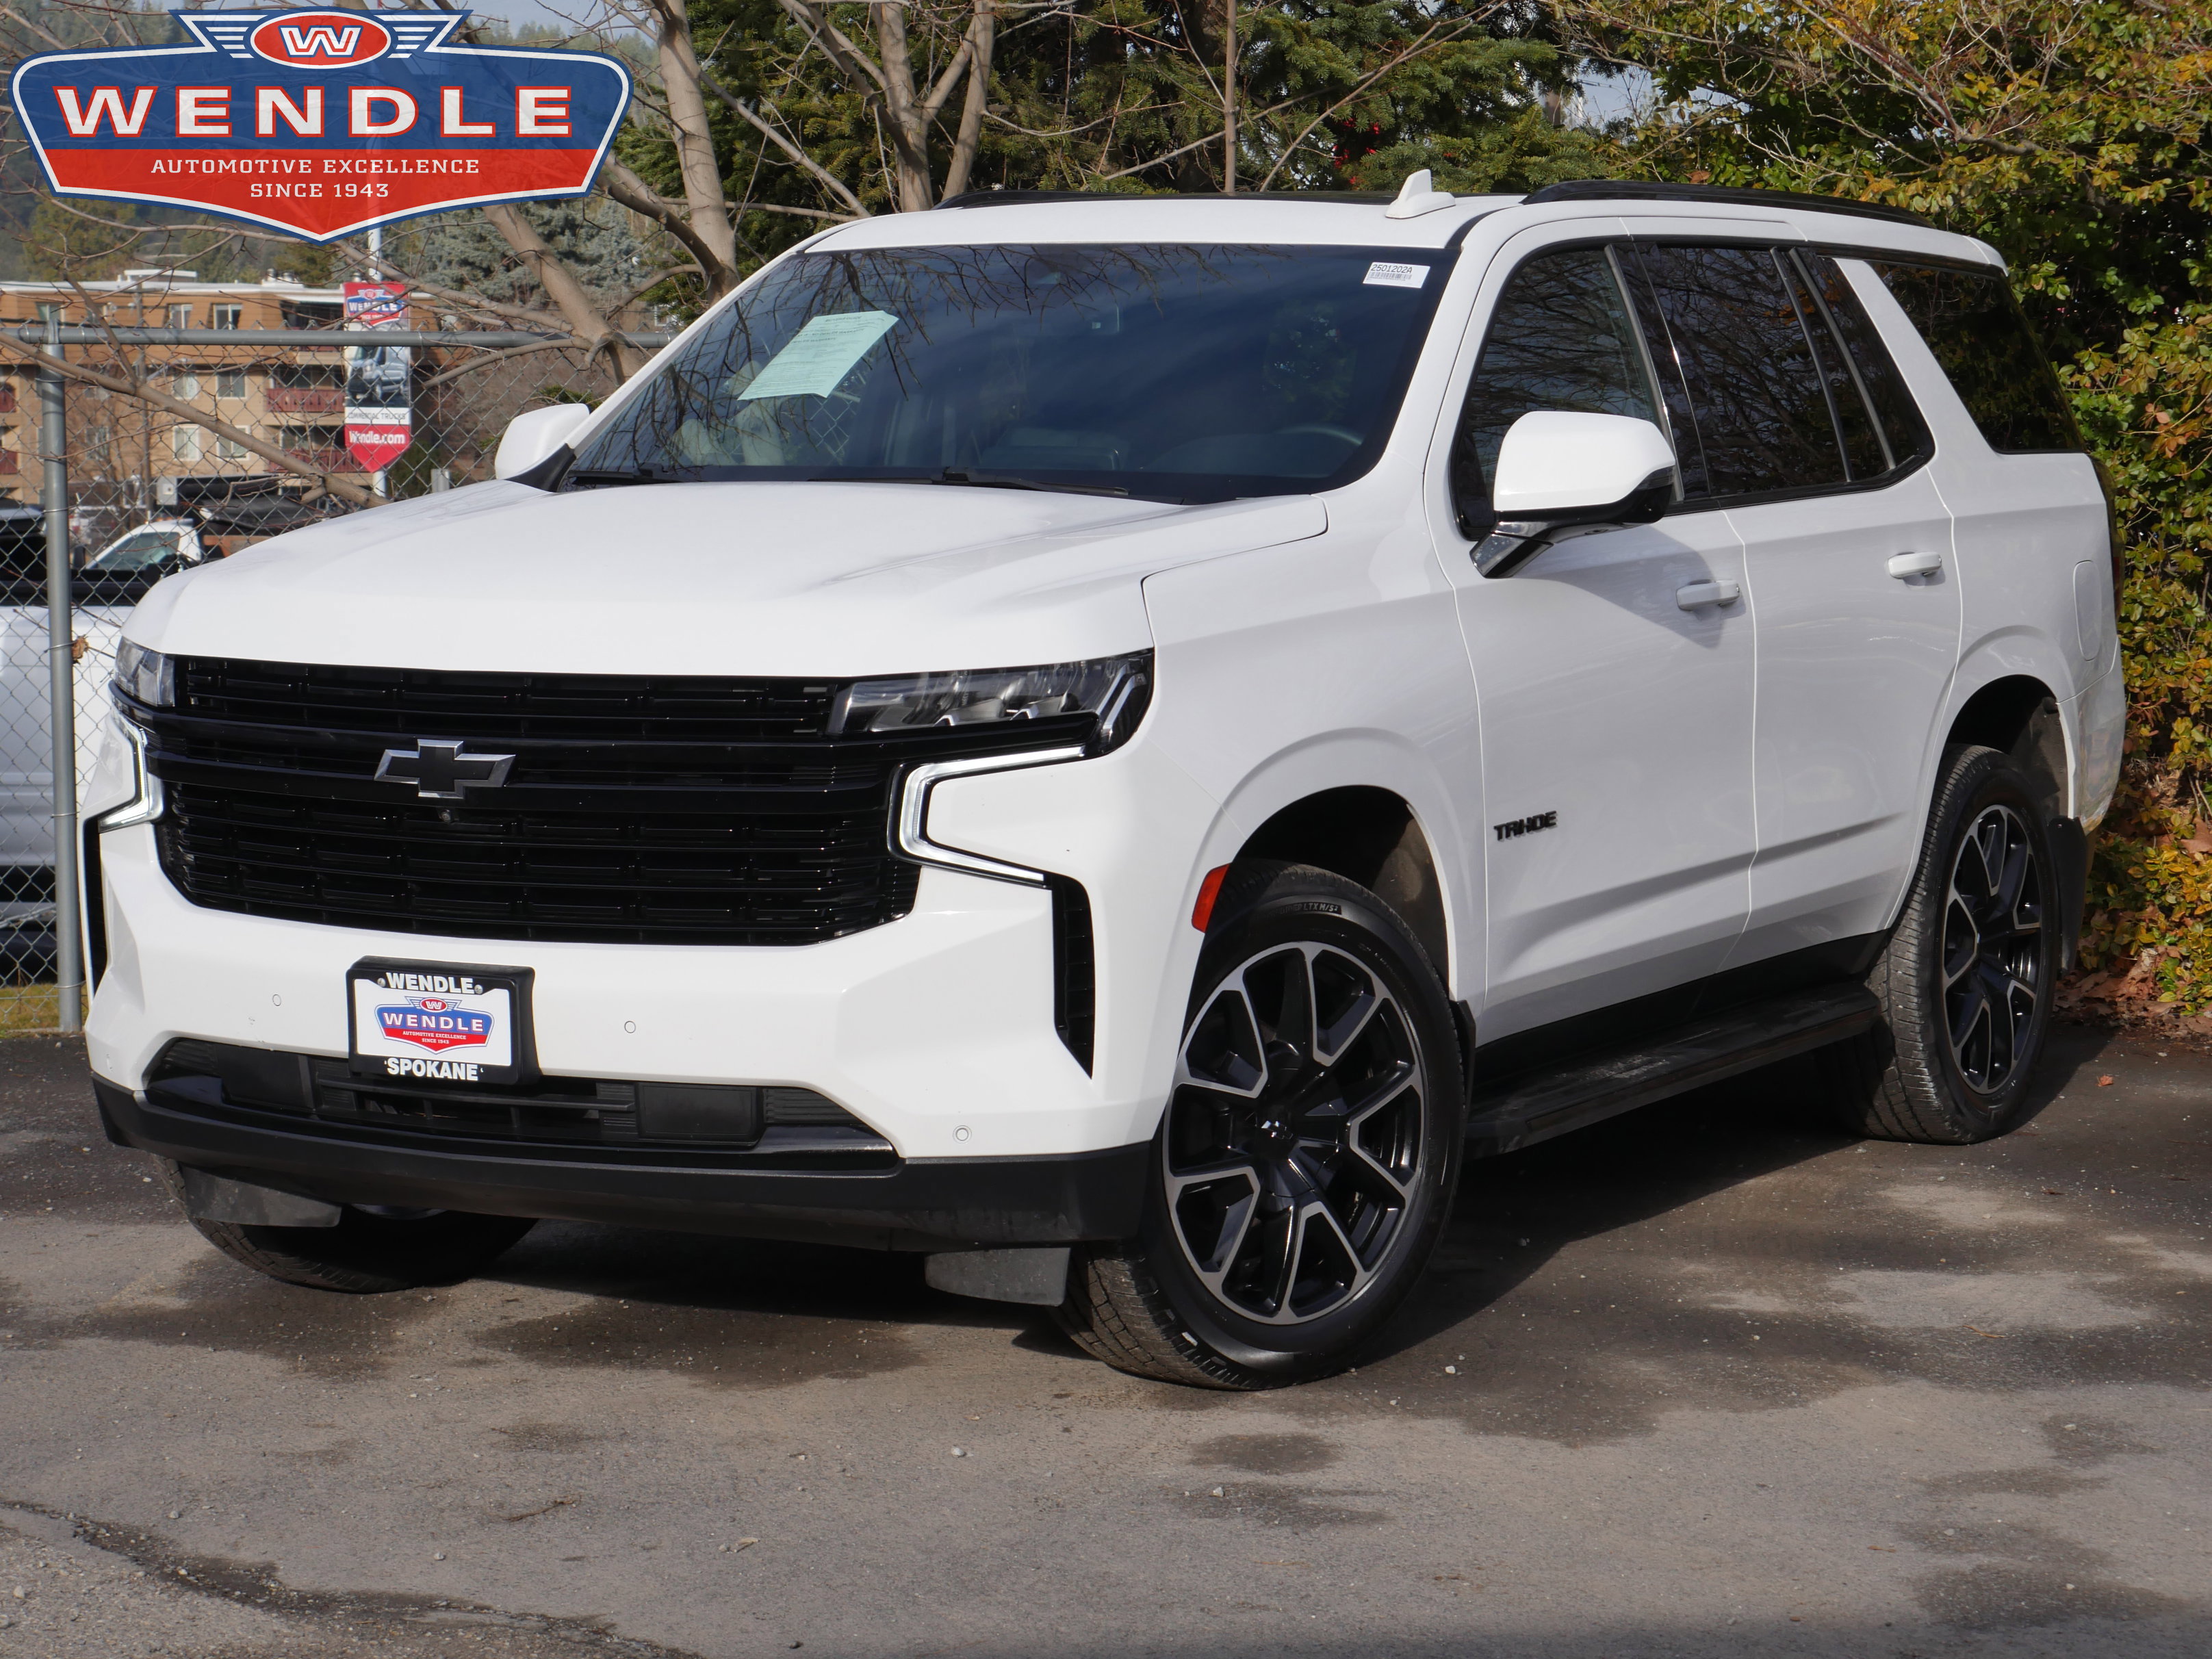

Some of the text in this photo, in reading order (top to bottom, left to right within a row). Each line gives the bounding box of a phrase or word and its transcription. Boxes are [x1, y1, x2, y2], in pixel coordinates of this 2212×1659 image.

[1371, 264, 1413, 274] 2501202A
[1493, 810, 1557, 841] TAHOE
[1303, 902, 1319, 911] LTX
[386, 972, 474, 994] WENDLE
[383, 1012, 483, 1032] WENDLE
[387, 1057, 478, 1081] SPOKANE
